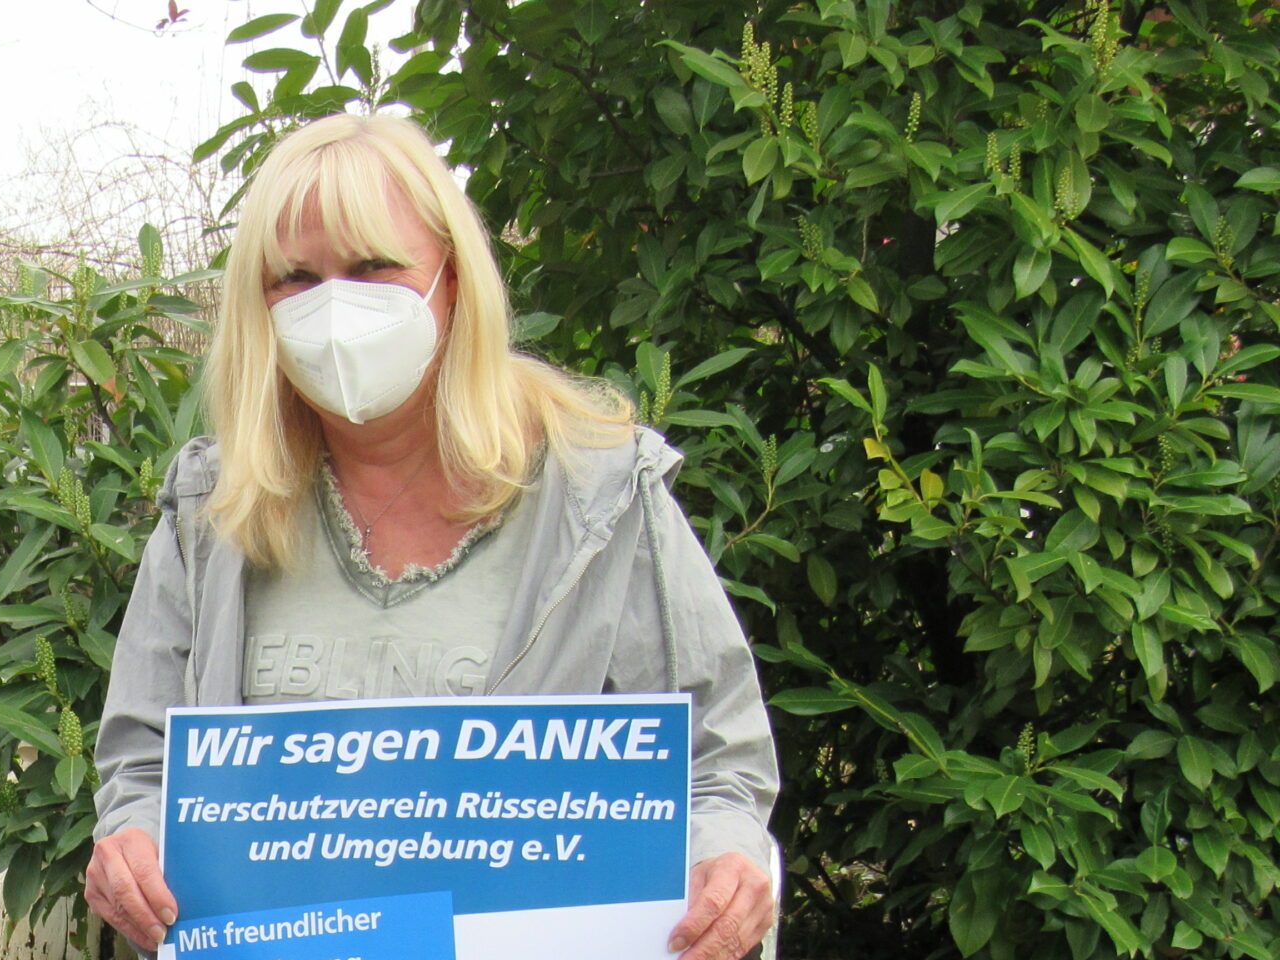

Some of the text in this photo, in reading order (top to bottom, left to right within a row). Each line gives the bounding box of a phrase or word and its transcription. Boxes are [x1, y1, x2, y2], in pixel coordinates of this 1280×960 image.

[187, 718, 669, 774] Wir sagen DANKE.
[178, 791, 675, 822] Tierschutzverein Rüsselsheim
[249, 832, 585, 868] und Umgebung e.V.
[179, 909, 381, 952] Mit freundlicher
